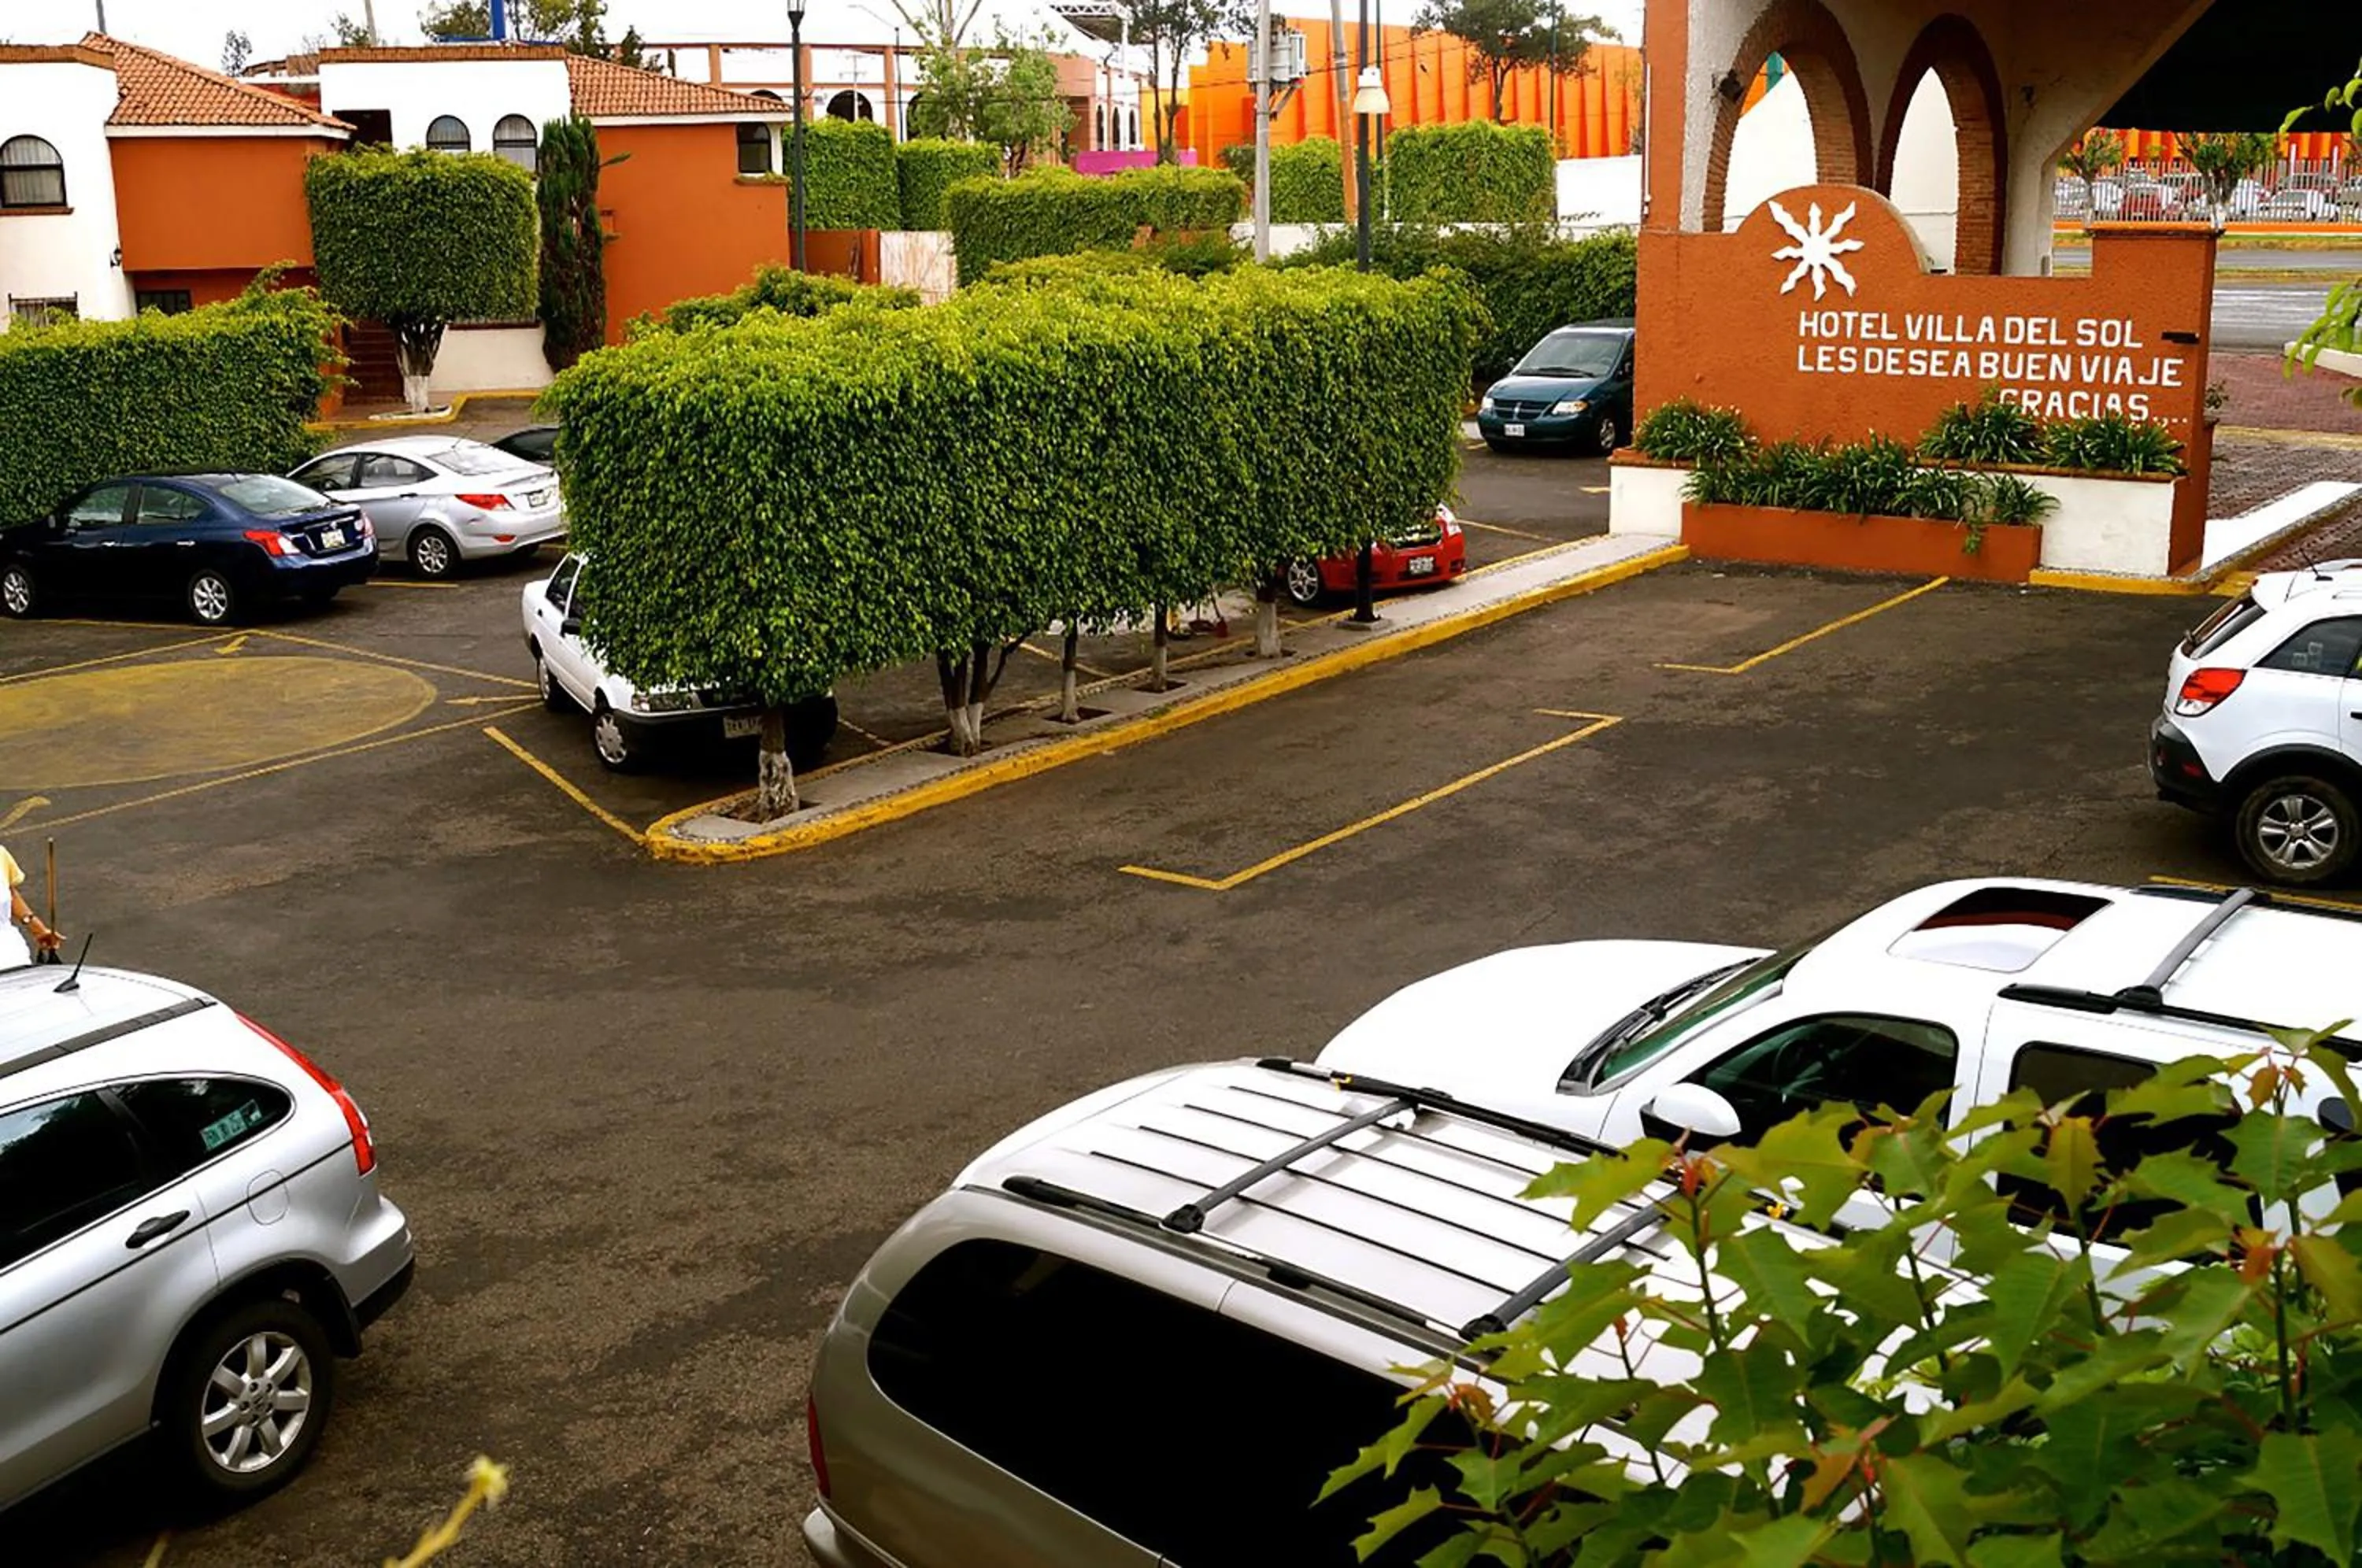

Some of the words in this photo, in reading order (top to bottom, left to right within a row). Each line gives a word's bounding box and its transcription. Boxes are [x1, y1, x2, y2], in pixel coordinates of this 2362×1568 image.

[1798, 311, 1898, 340] HOTEL
[1905, 314, 1997, 343] VILLA
[2004, 316, 2068, 346] DEL
[2076, 319, 2143, 348] SOL
[1797, 345, 1857, 373] LES
[1864, 347, 1971, 378] DESEA
[1979, 352, 2071, 382] BUEN
[2080, 355, 2184, 386] VIAJE
